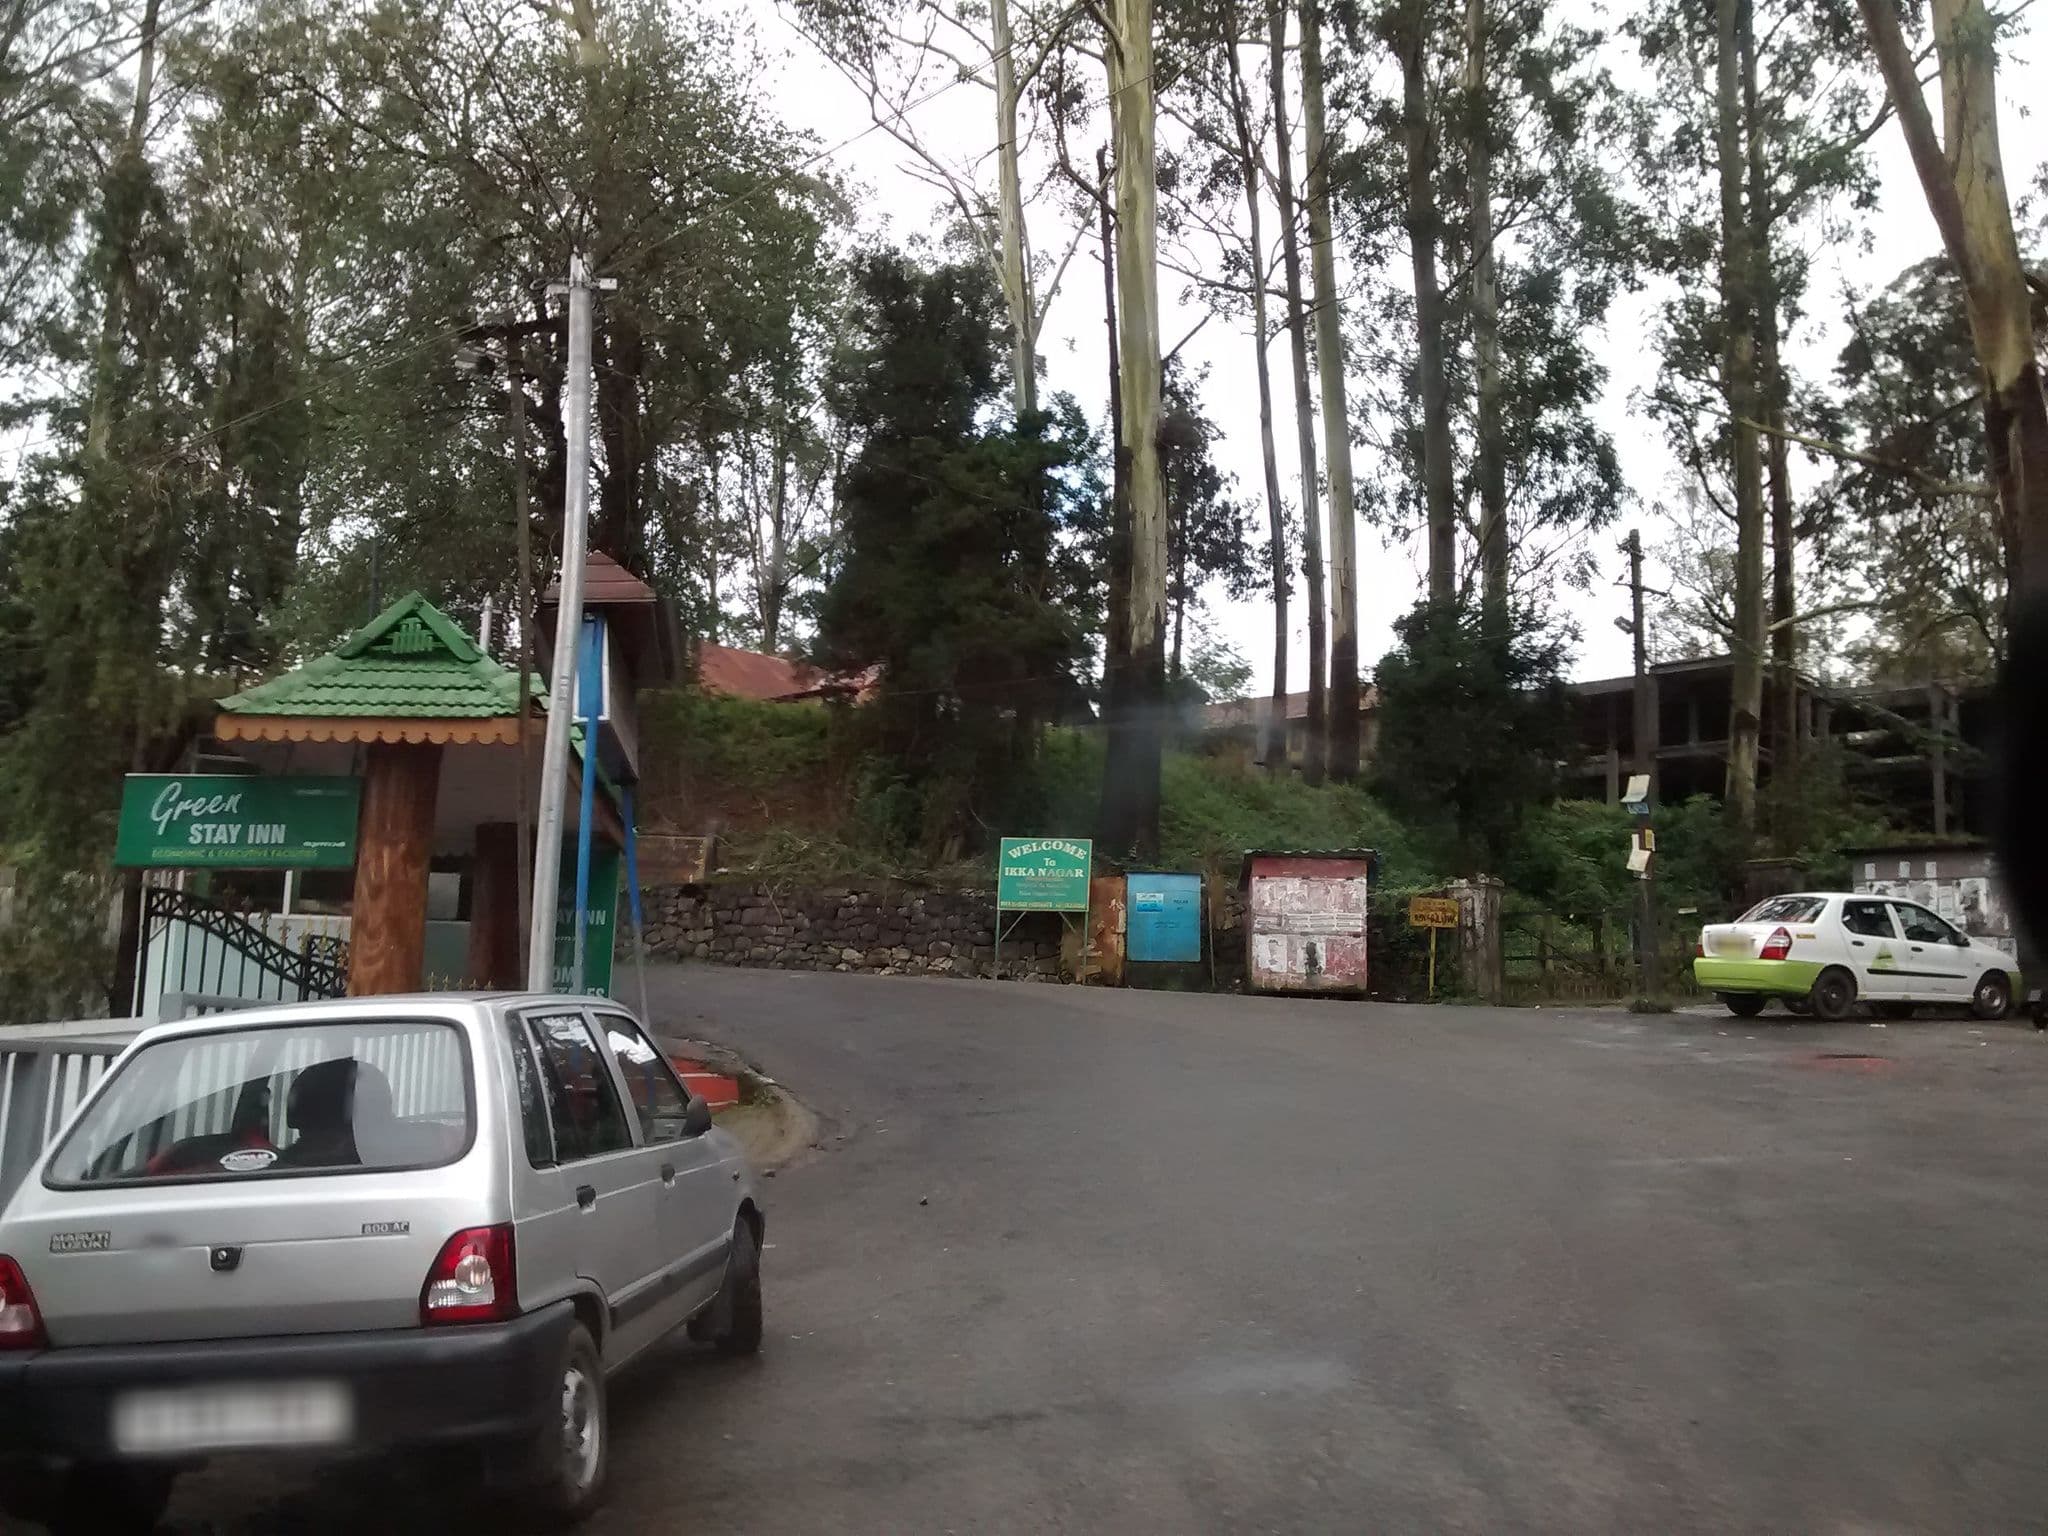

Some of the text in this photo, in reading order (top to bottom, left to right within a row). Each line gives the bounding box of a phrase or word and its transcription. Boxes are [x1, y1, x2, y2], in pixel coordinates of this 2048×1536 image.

[151, 781, 242, 835] Green
[189, 824, 286, 845] STAY INN
[1008, 840, 1087, 860] WELCOME
[1044, 858, 1056, 867] To
[1004, 867, 1084, 878] IKKA NAGAR
[364, 1222, 409, 1233] 800 AC
[53, 1232, 109, 1241] MARUTI
[52, 1240, 108, 1249] SUZUKI
